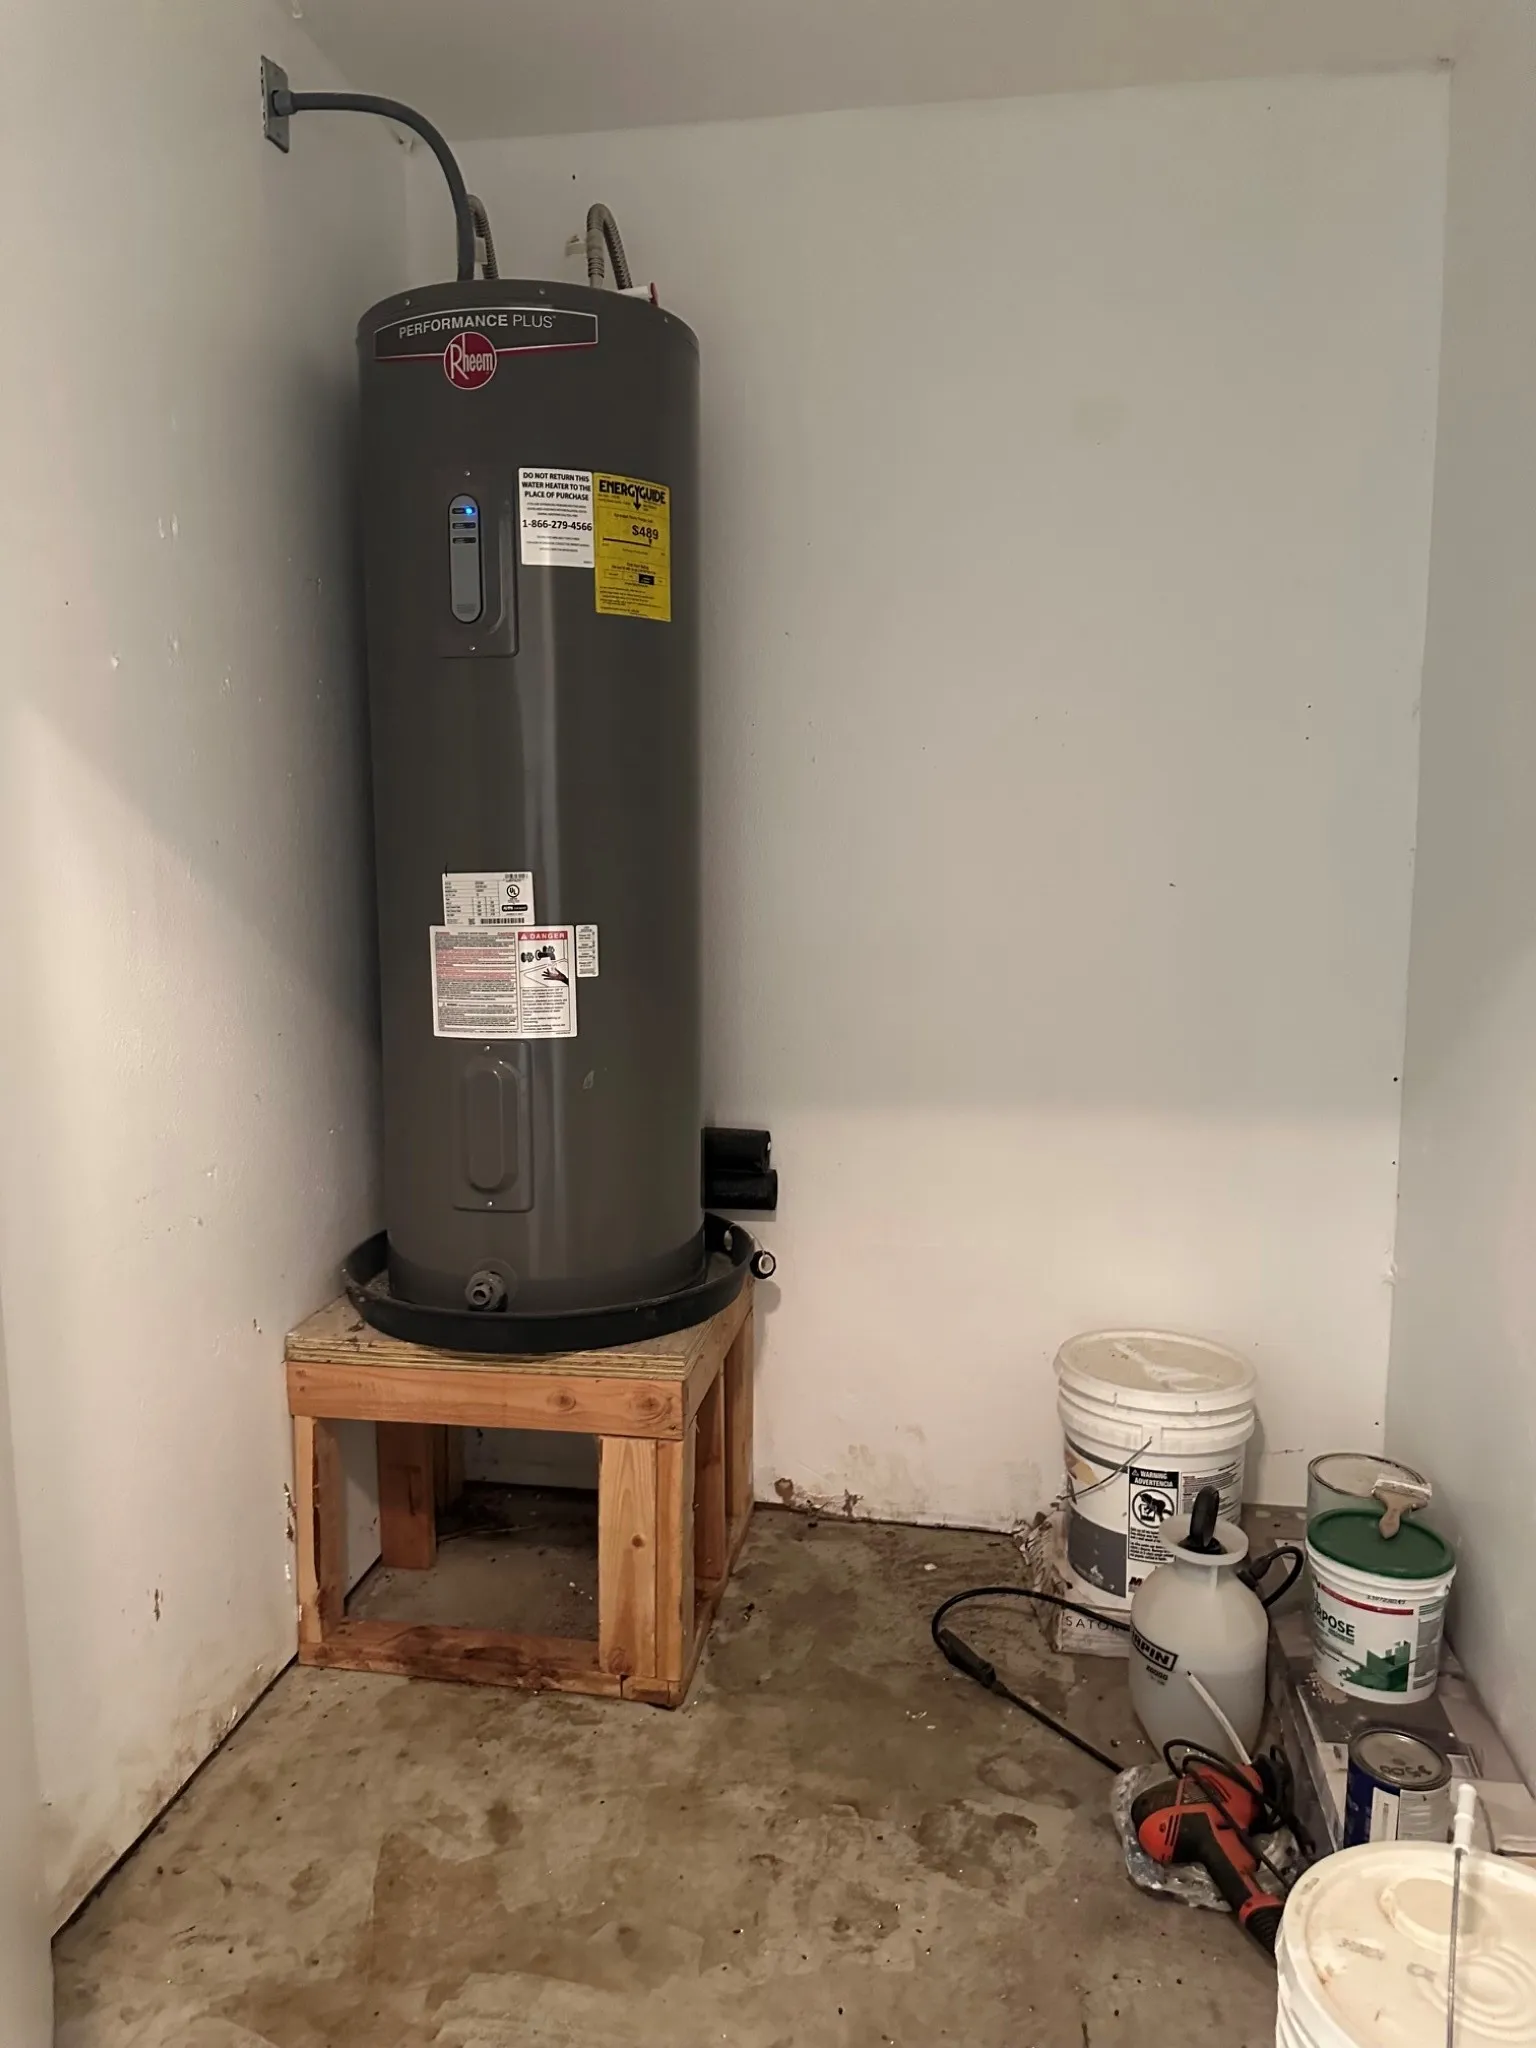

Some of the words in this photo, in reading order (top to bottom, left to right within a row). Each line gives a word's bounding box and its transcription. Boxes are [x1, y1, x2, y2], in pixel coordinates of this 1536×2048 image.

[399, 315, 508, 338] PERFORMANCE
[512, 314, 553, 329] PLUS
[449, 333, 494, 380] Rheem
[522, 481, 544, 489] WATER
[544, 482, 570, 490] HEATER
[570, 483, 579, 491] TO
[579, 484, 591, 492] THE
[599, 479, 666, 505] ENERGYGUIDE
[524, 490, 545, 498] PLACE
[546, 491, 555, 499] OF
[555, 492, 589, 501] PURCHASE
[522, 519, 592, 531] 1-866-279-4566
[631, 524, 659, 540] $489
[1140, 1470, 1168, 1480] WARNING
[1134, 1477, 1174, 1488] ADVERTENCIA
